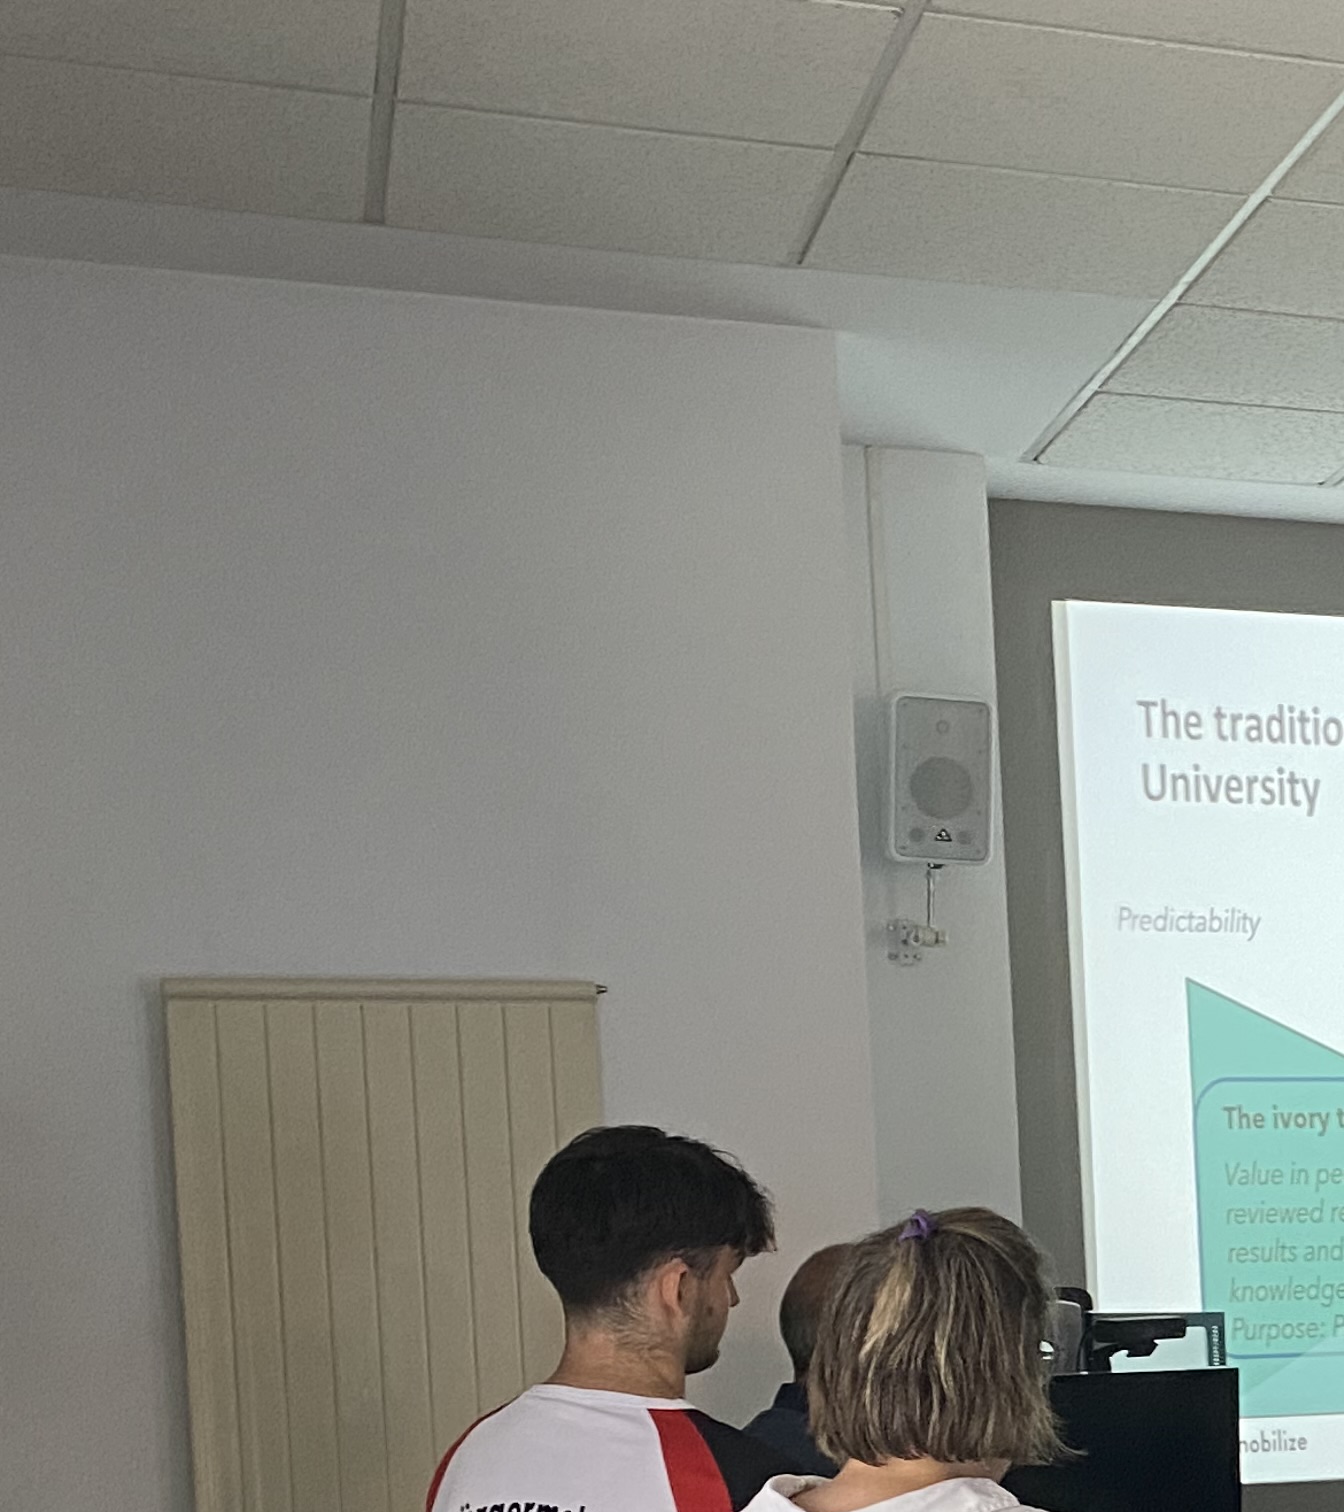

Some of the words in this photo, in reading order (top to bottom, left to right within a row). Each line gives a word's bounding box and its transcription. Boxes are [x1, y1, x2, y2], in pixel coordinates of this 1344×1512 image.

[1137, 699, 1202, 741] The
[1141, 763, 1320, 817] University
[1118, 906, 1261, 941] Predictability
[1223, 1104, 1265, 1129] The
[1272, 1104, 1330, 1137] ivory
[1225, 1160, 1284, 1186] Value
[1290, 1161, 1309, 1185] in
[1226, 1197, 1324, 1225] reviewed
[1227, 1237, 1297, 1263] results
[1303, 1236, 1344, 1262] and
[1231, 1317, 1326, 1347] Purpose:
